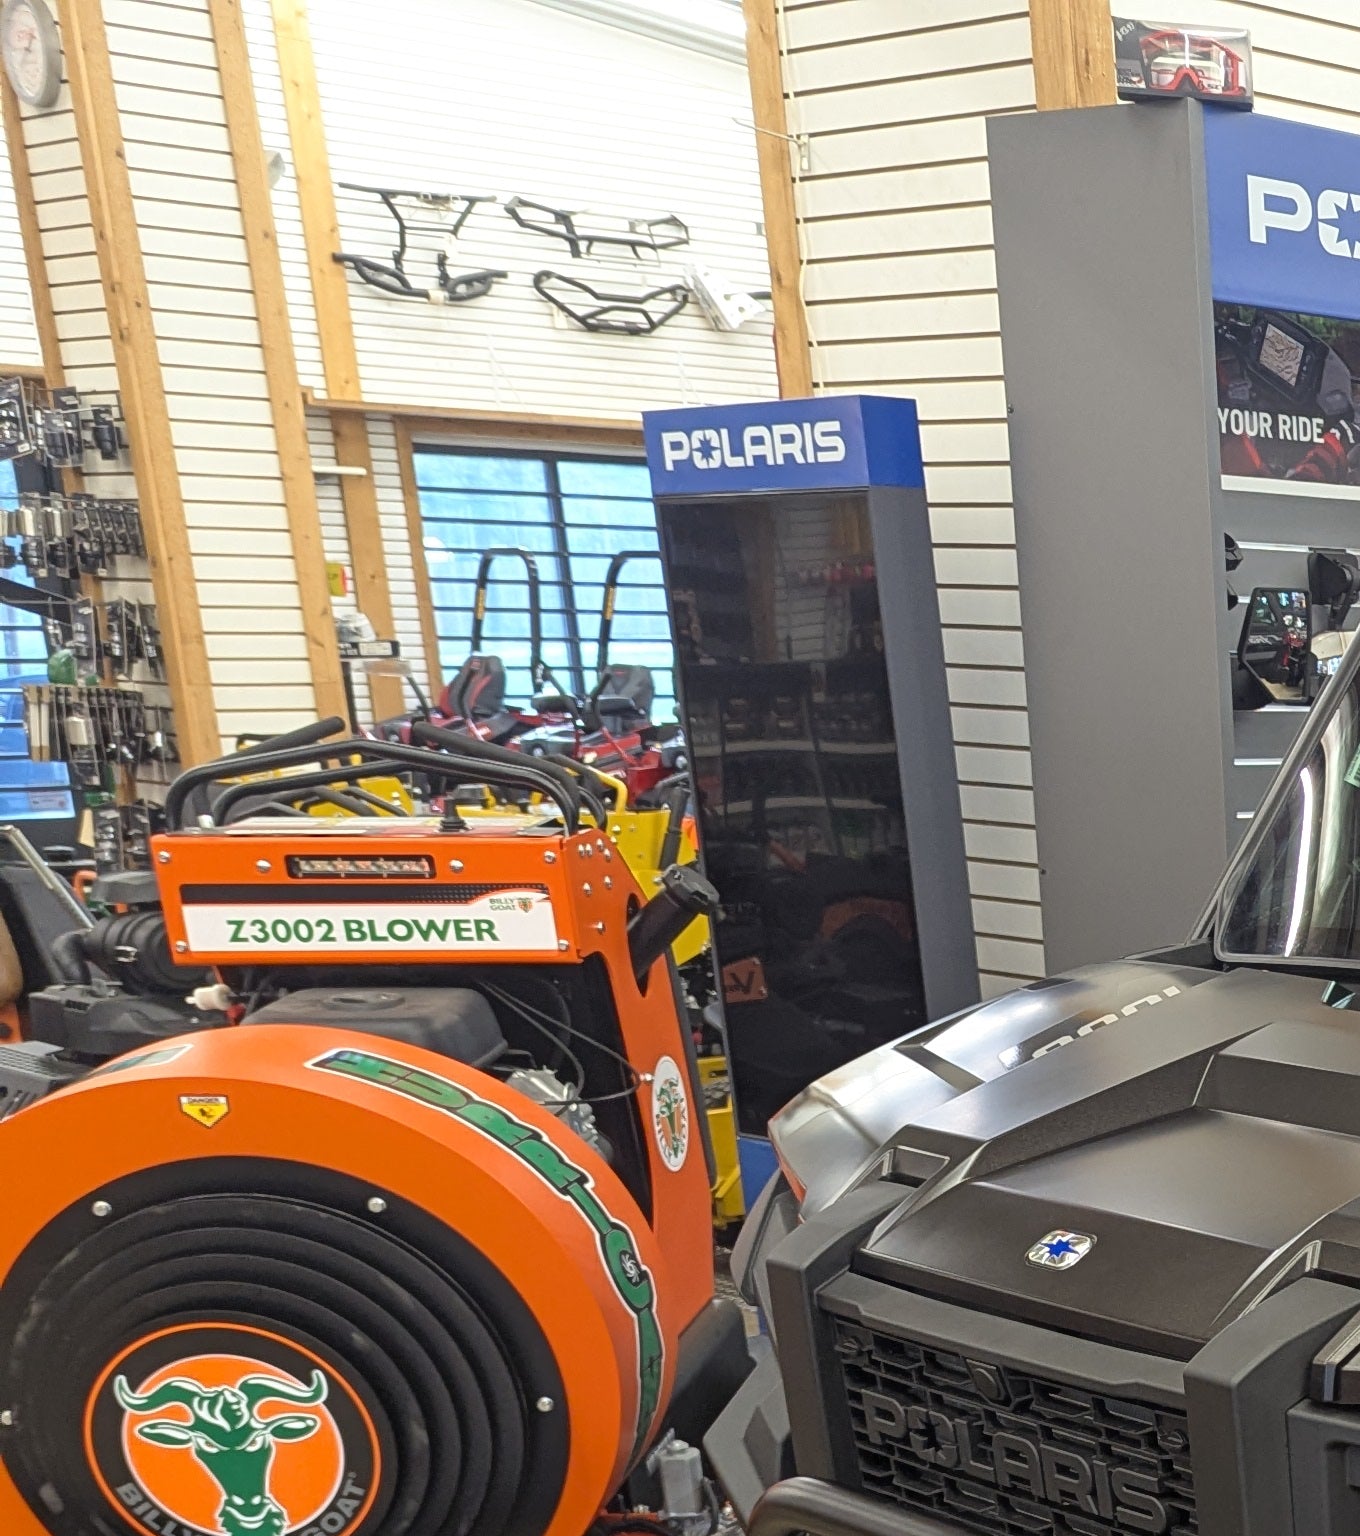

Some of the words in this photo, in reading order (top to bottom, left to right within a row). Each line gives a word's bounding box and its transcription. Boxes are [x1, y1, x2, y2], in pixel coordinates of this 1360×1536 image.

[1217, 407, 1273, 439] YOUR
[1278, 413, 1325, 443] RIDE
[661, 420, 845, 471] POLARIS
[489, 897, 515, 905] BILLY
[226, 919, 336, 943] Z3002
[342, 919, 500, 943] BLOWER
[861, 1389, 1167, 1534] POLARIS
